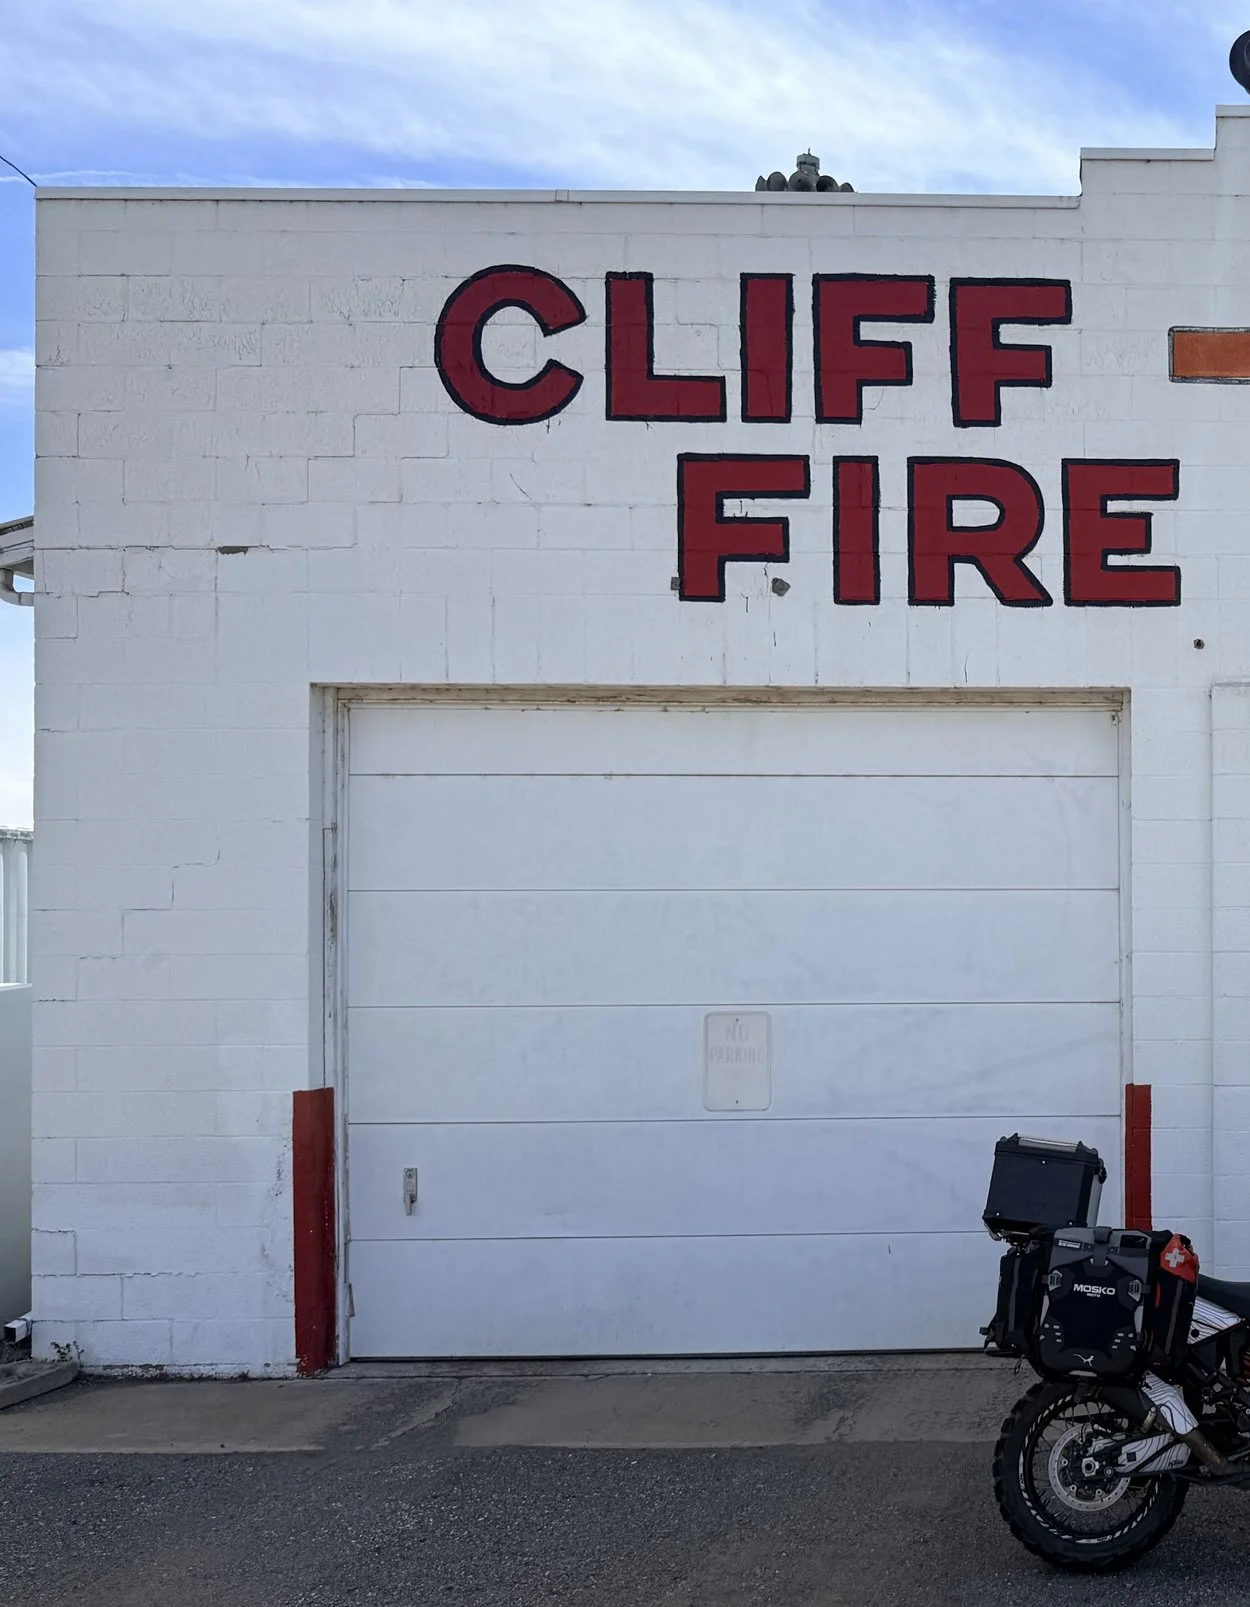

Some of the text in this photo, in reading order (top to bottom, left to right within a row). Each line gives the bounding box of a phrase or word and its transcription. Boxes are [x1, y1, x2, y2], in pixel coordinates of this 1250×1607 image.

[435, 265, 1072, 426] CLIFF
[677, 453, 1181, 606] FIRE
[726, 1024, 749, 1041] NO
[710, 1046, 766, 1064] PARKING
[1073, 1283, 1116, 1295] MOSKO
